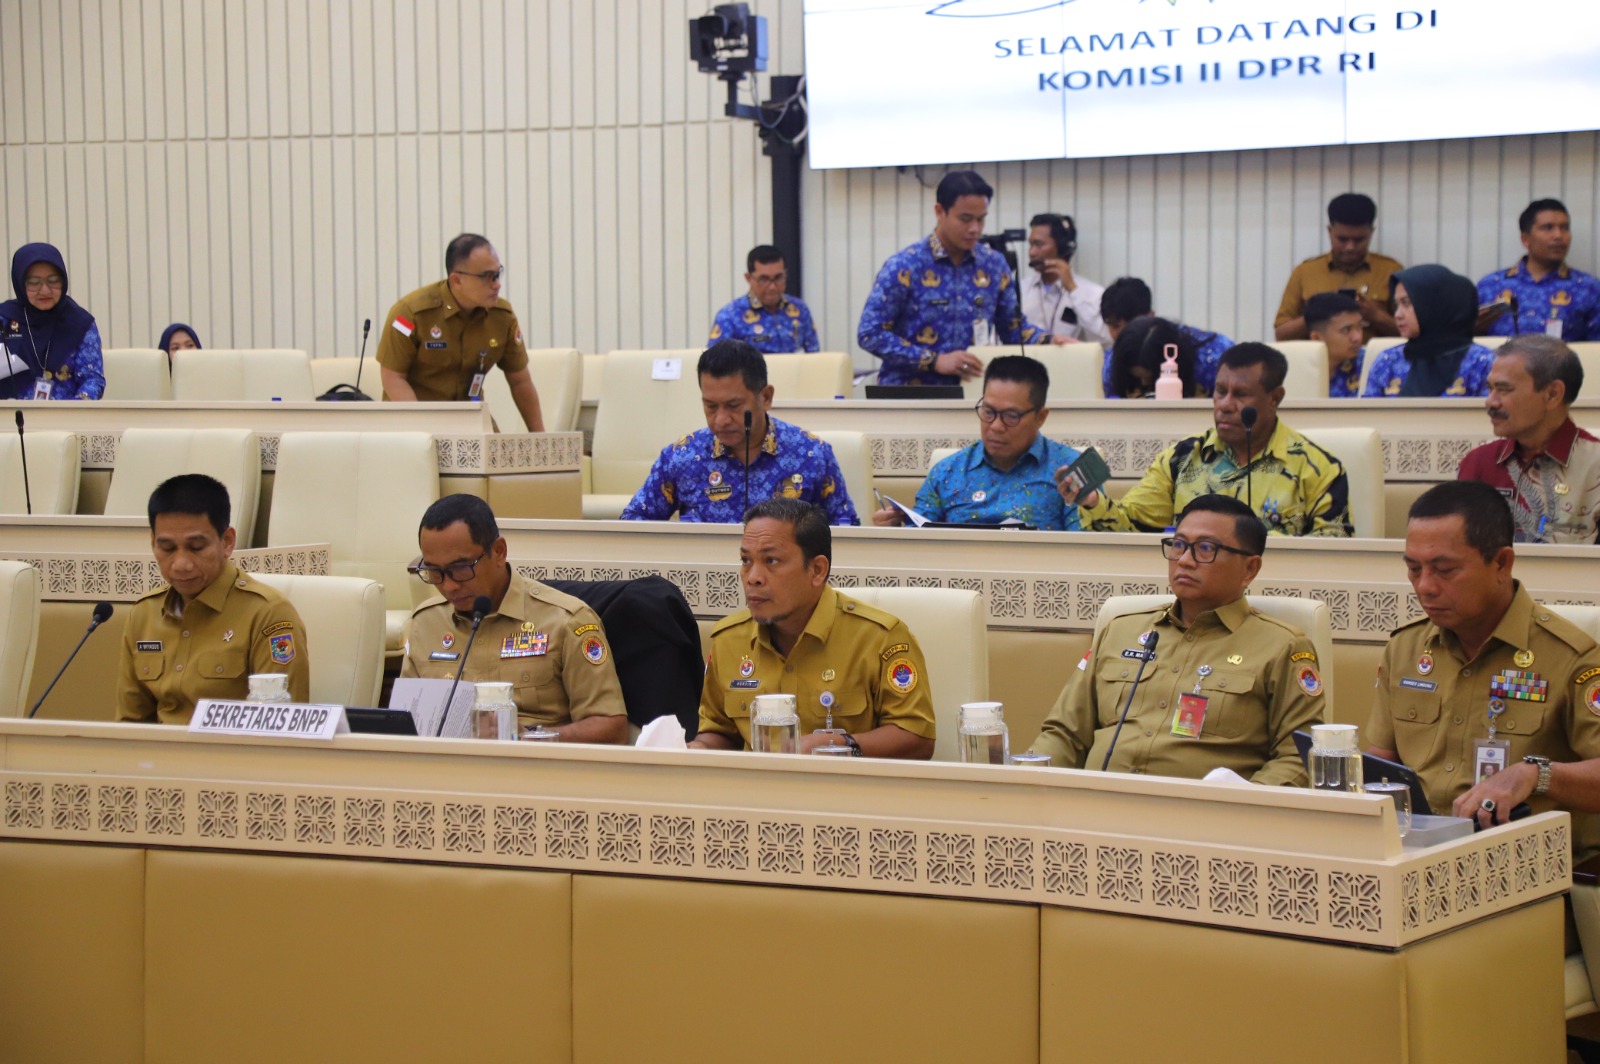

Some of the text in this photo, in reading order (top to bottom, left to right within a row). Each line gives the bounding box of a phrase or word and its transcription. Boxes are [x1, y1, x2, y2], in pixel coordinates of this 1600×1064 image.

[994, 9, 1438, 59] SELAMAT DATANG DI
[1038, 52, 1377, 91] KOMISI II DPR RI
[202, 704, 329, 733] SEKRETARIS BNPP
